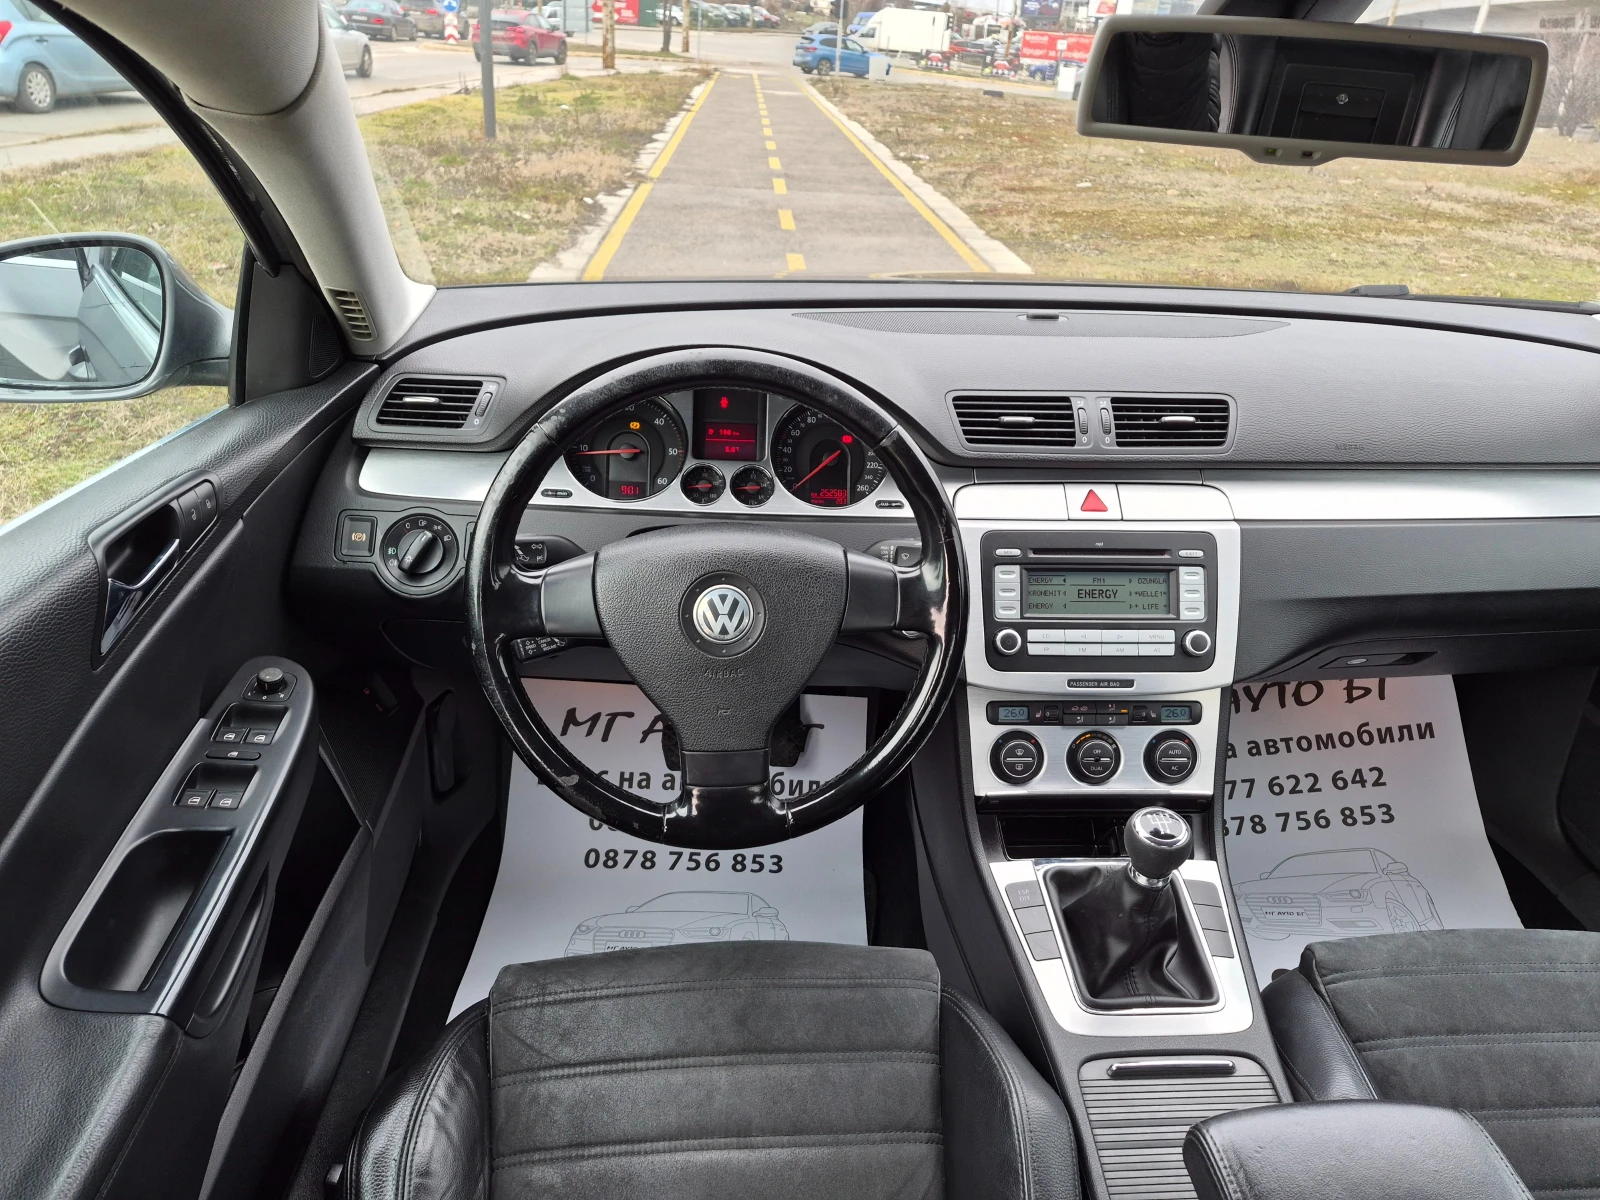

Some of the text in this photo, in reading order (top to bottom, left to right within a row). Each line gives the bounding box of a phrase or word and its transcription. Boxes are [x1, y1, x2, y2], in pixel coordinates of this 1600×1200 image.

[654, 418, 665, 426] 40
[806, 416, 817, 424] 80
[790, 429, 801, 437] 60
[579, 444, 589, 452] 10
[668, 447, 678, 456] 50
[782, 446, 792, 454] 40
[783, 465, 793, 473] 20
[866, 461, 878, 469] 220
[590, 474, 596, 482] 0
[657, 477, 668, 485] 60
[856, 484, 870, 492] 260
[1028, 589, 1062, 597] KRONEHIT
[1077, 588, 1119, 599] ENERGY
[1028, 602, 1054, 610] ENERGY
[1003, 708, 1025, 718] 26.0
[1164, 708, 1187, 718] 26.0
[1246, 721, 1436, 757] автомобили
[618, 771, 652, 790] на
[1224, 766, 1387, 800] 77 622 642
[1275, 808, 1331, 832] 756
[1340, 803, 1395, 827] 853
[584, 848, 784, 873] 0878 756 853
